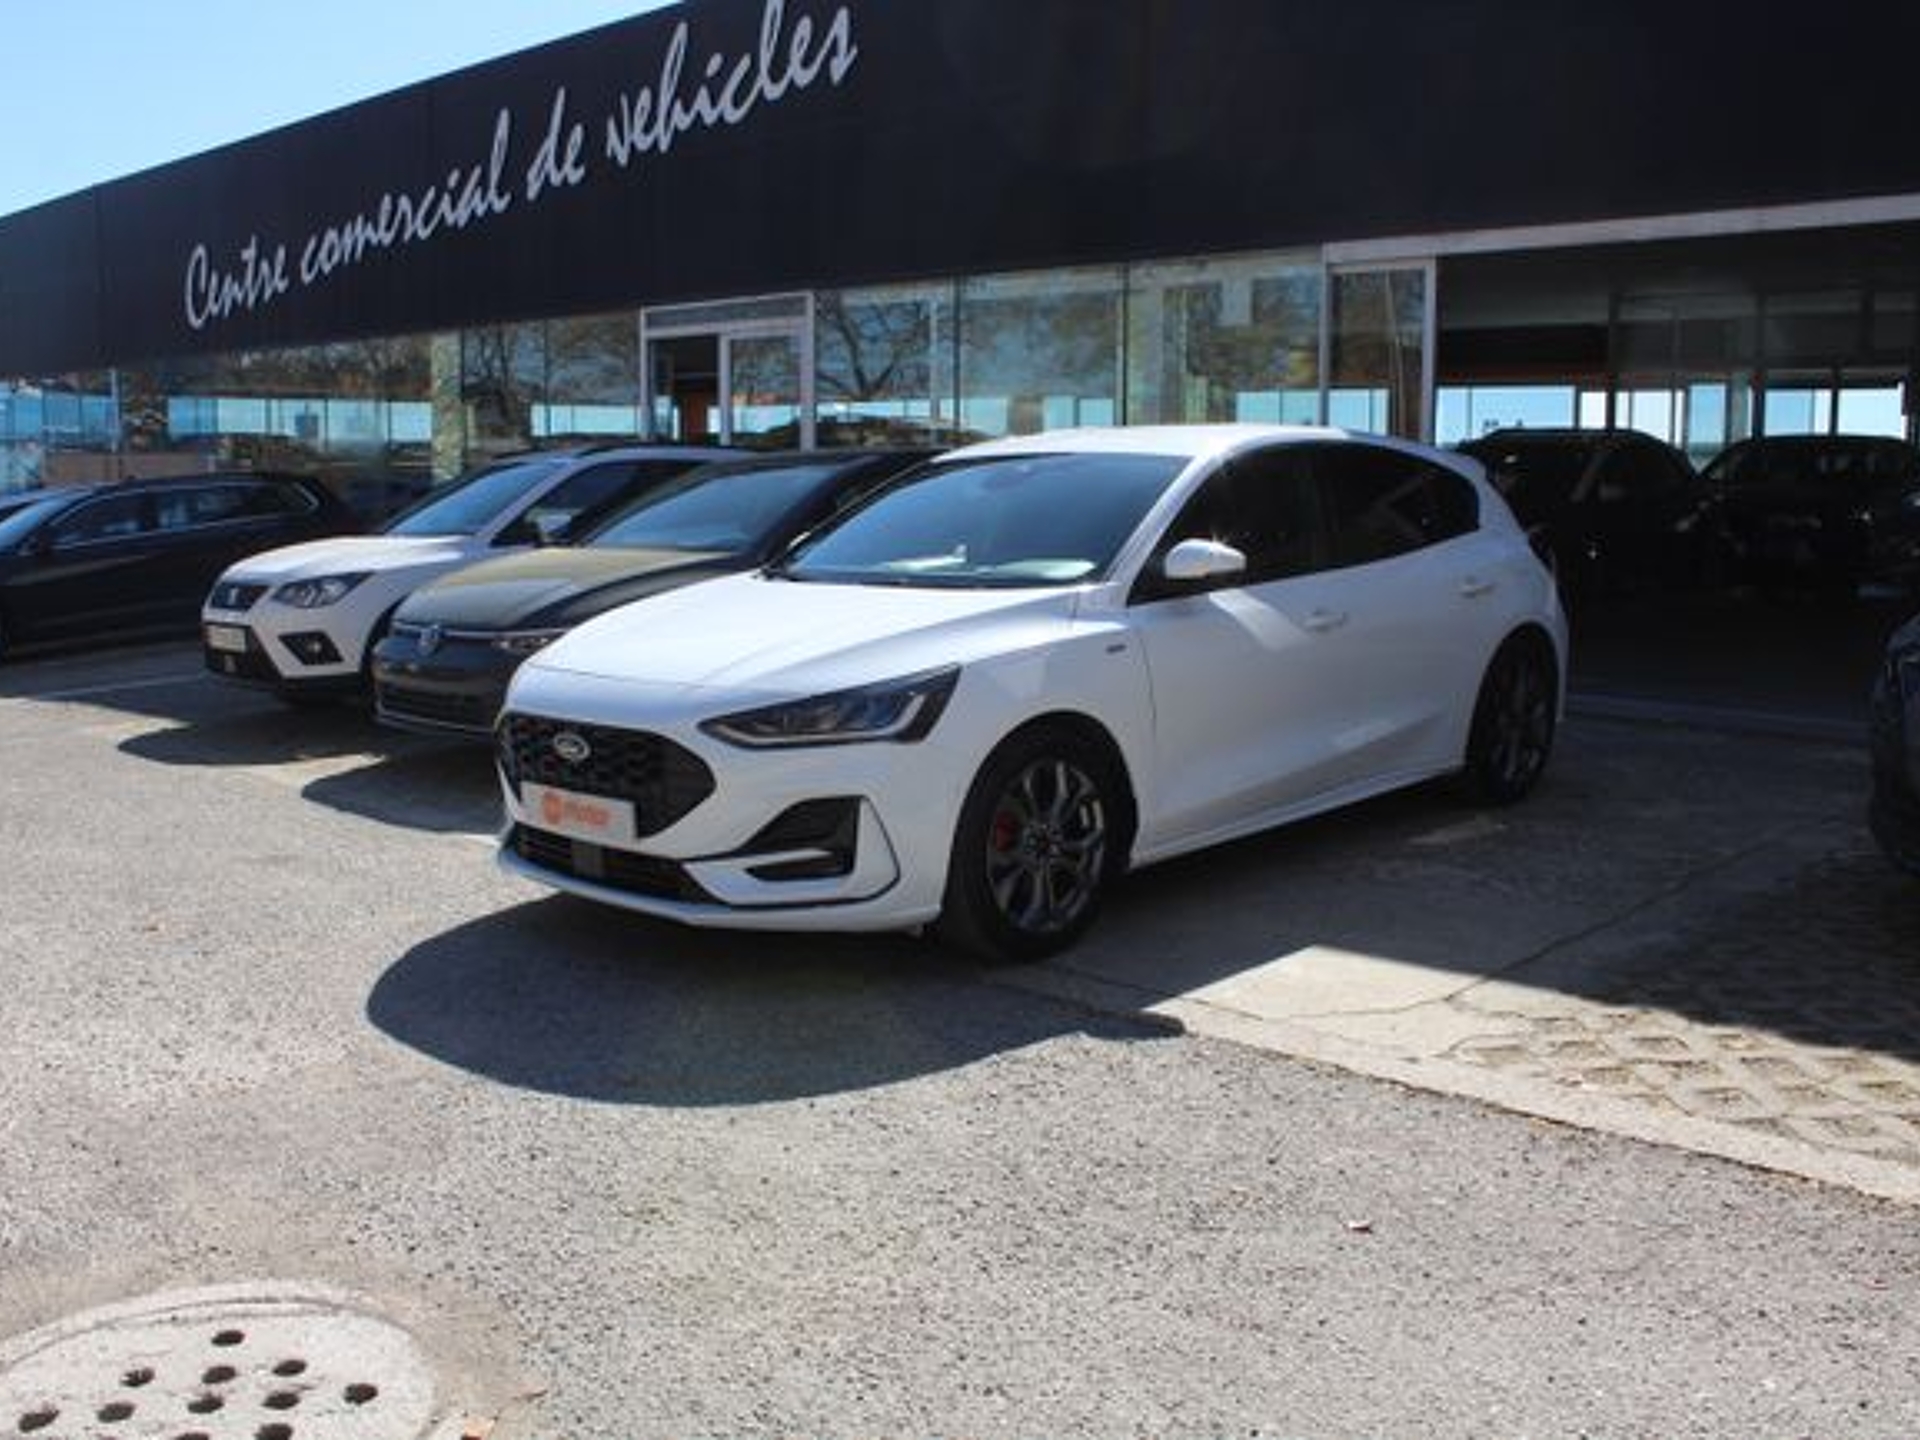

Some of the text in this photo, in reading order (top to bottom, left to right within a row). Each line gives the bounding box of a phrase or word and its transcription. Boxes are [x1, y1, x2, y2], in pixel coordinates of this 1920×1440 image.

[185, 0, 858, 329] Centre comercial de vehicles
